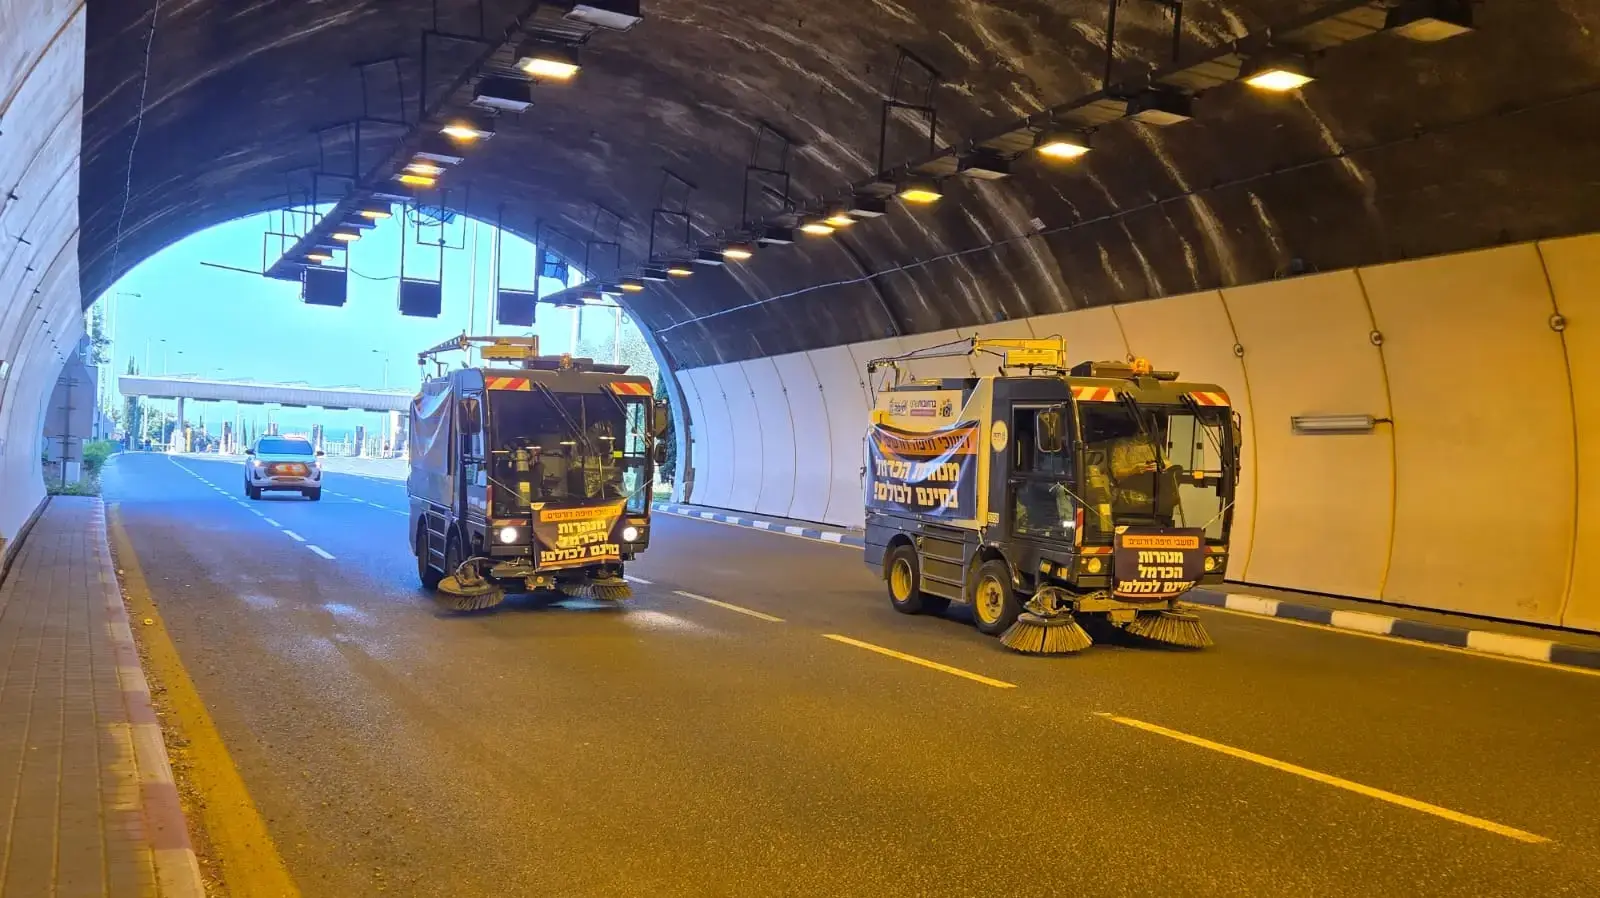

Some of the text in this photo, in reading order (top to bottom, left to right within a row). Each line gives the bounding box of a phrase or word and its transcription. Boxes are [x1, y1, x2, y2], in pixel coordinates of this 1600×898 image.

[875, 459, 911, 479] הכרמל
[874, 480, 958, 508] בחינם לכולם!
[558, 520, 606, 533] מנהרות
[556, 532, 608, 547] הכרמל
[541, 546, 586, 561] לכולם!
[1138, 551, 1183, 563] מנהרות
[1138, 564, 1183, 578] הכרמל
[1117, 579, 1161, 592] לכולם!
